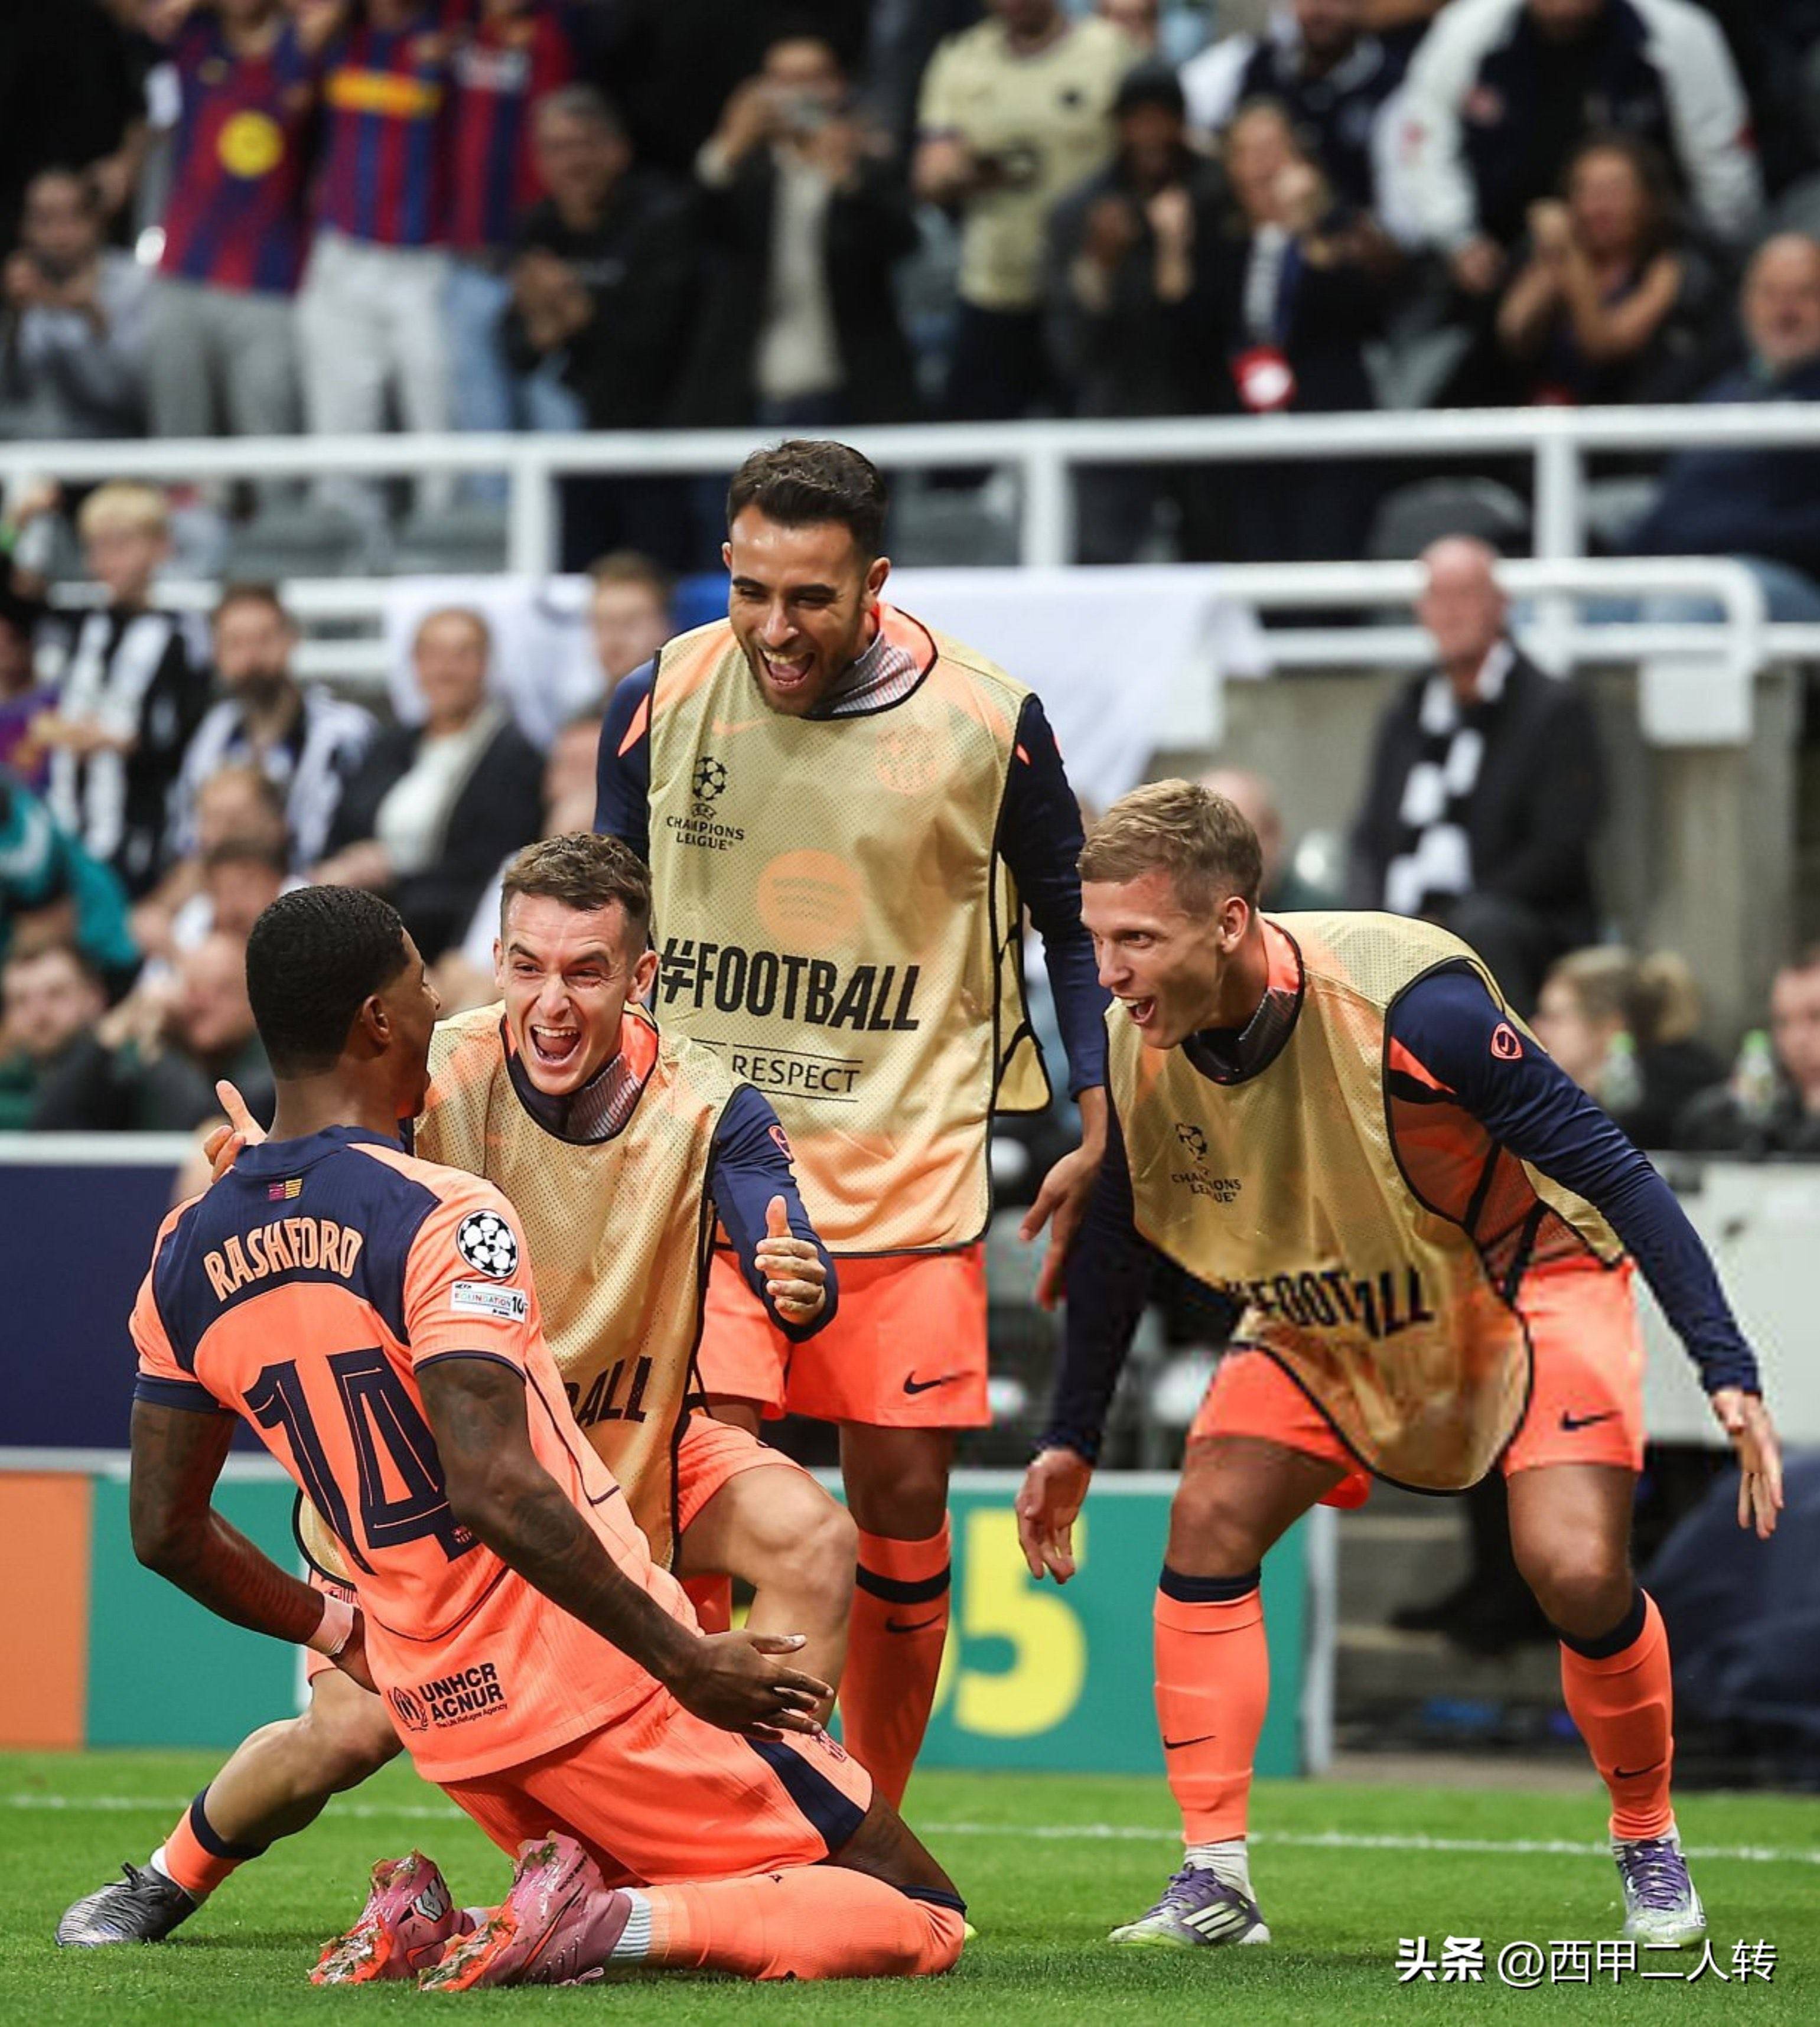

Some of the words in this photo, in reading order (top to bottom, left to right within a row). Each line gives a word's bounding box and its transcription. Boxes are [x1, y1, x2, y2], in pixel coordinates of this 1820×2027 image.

[666, 816, 744, 840] CHAMPIONS
[660, 938, 921, 1031] #FOOTBALL
[732, 1055, 861, 1093] RESPECT
[203, 1217, 363, 1302] RASHFORD
[242, 1347, 480, 1576] 14
[418, 1663, 497, 1702] UNHCR
[430, 1683, 504, 1722] ACNUR
